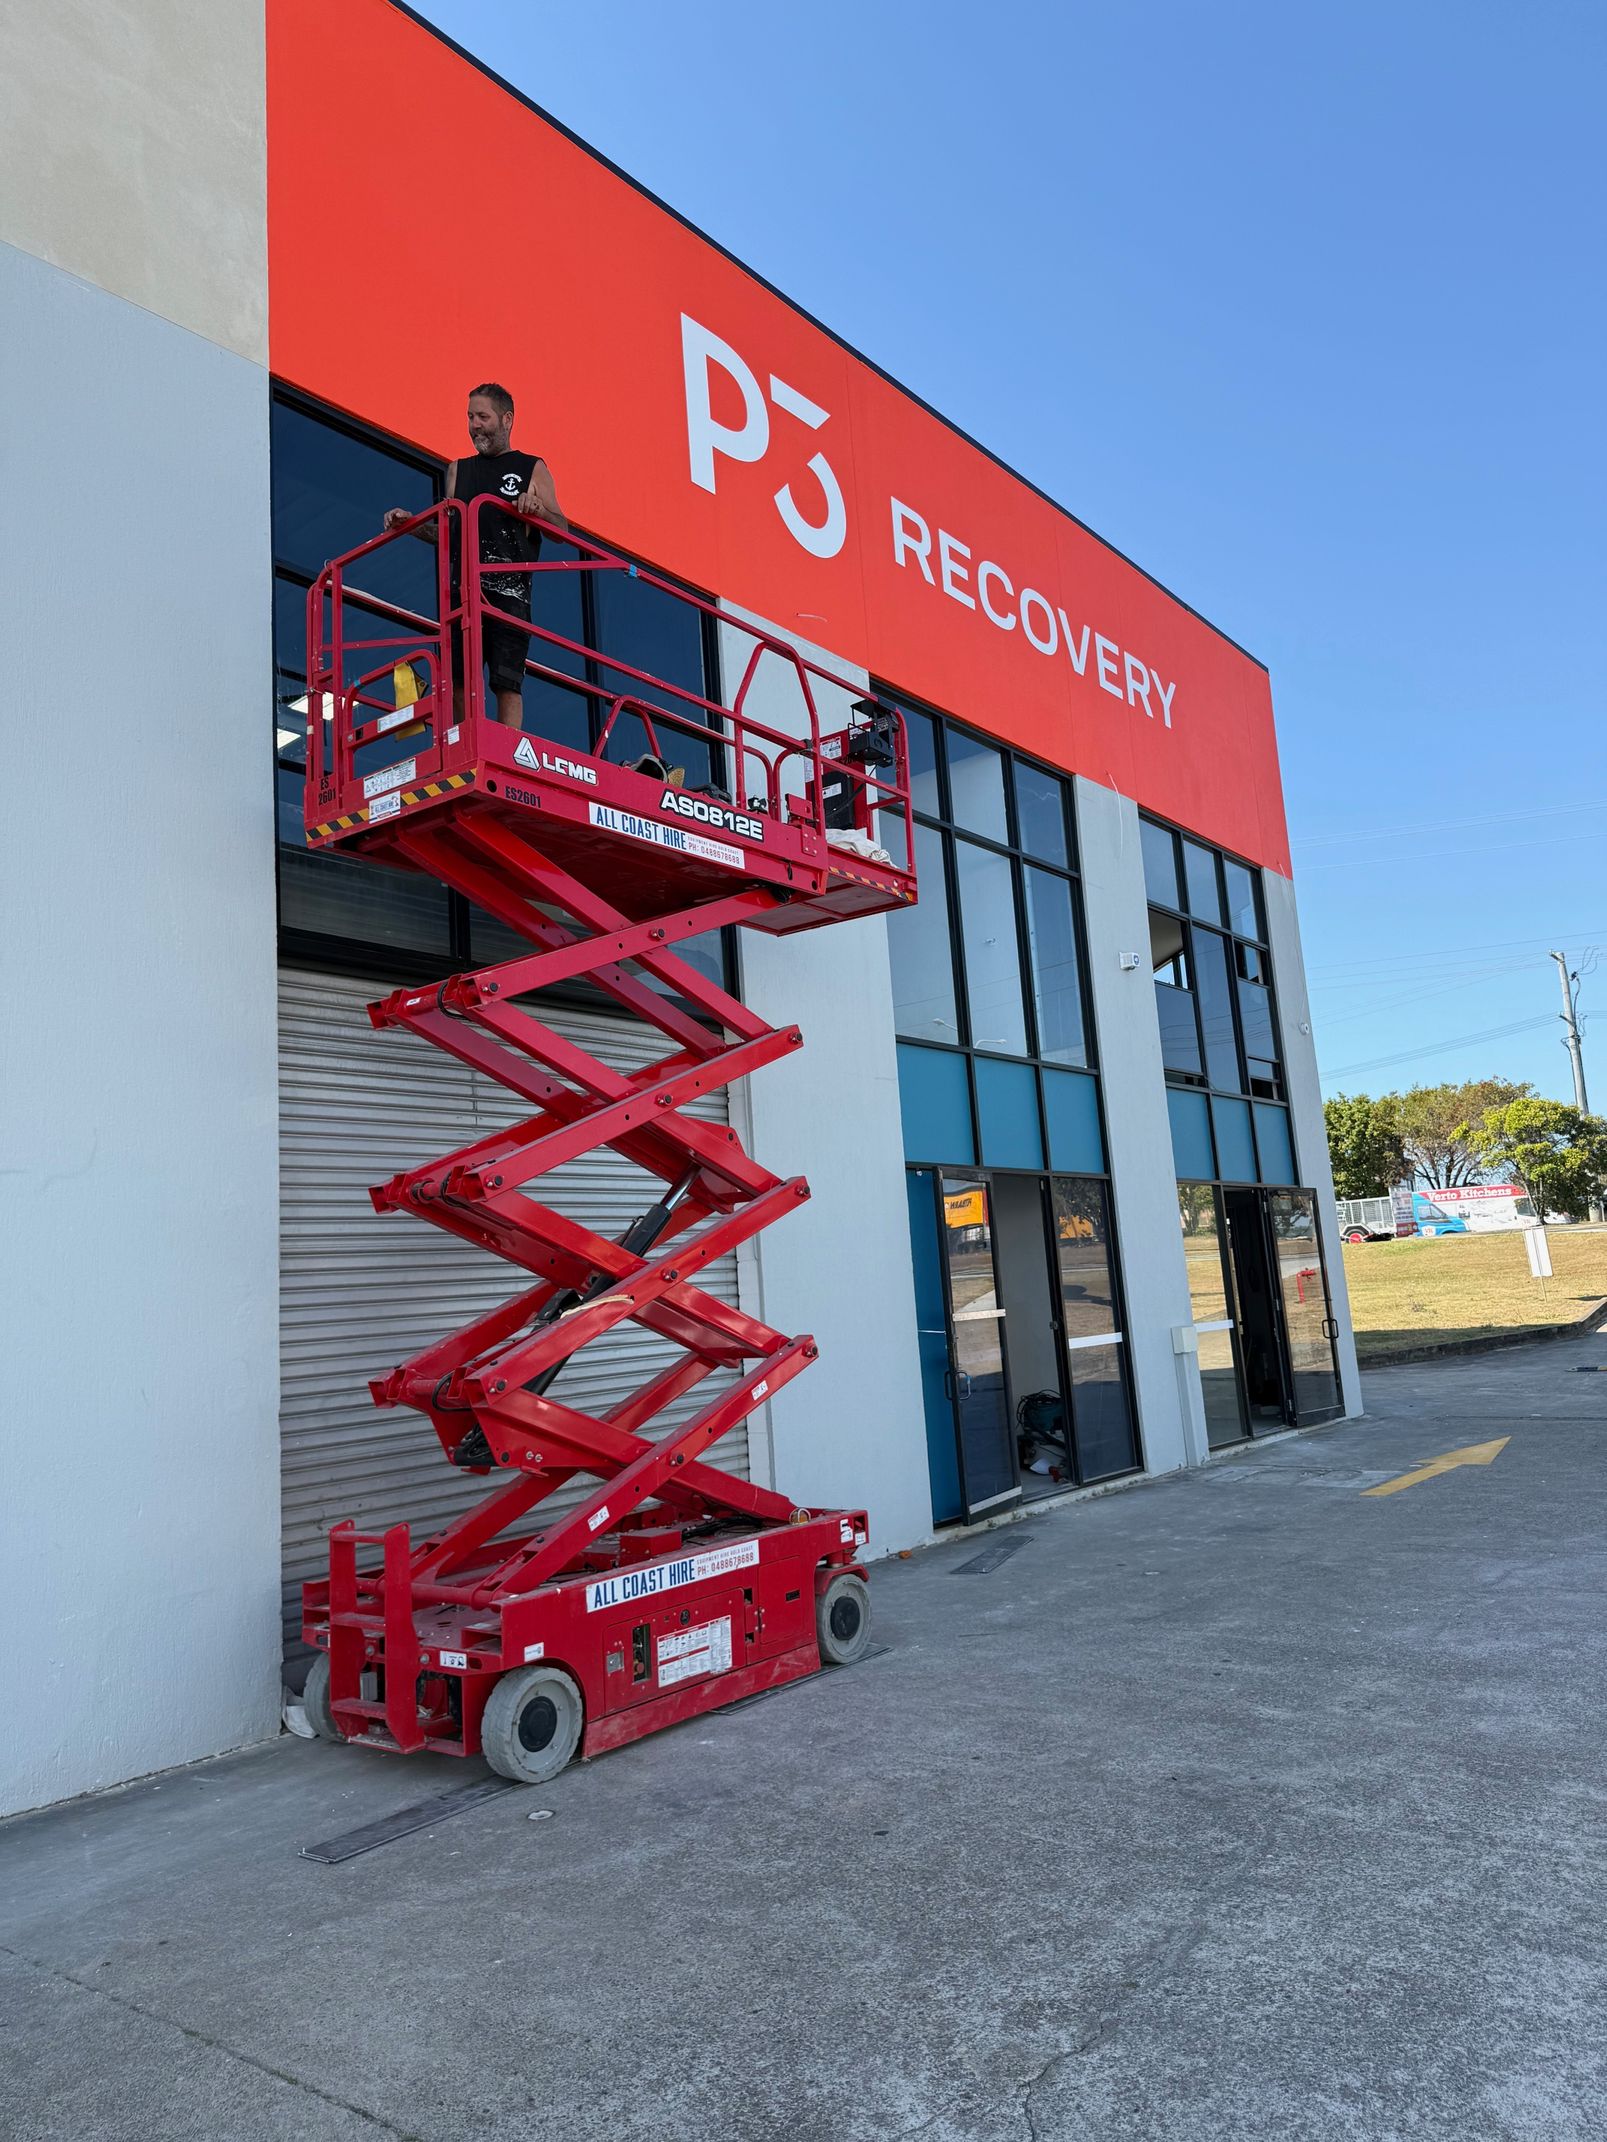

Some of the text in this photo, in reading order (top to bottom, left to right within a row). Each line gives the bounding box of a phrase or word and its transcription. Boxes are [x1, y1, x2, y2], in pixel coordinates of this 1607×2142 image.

[680, 312, 847, 559] P3
[890, 495, 1176, 729] RECOVERY
[318, 789, 335, 805] 2601
[320, 778, 329, 791] ES
[505, 786, 541, 808] ES2601
[596, 806, 687, 851] ALL COAST HIRE
[1427, 1188, 1512, 1201] Verto Kitchens
[594, 1558, 696, 1609] ALL COAST HIRE
